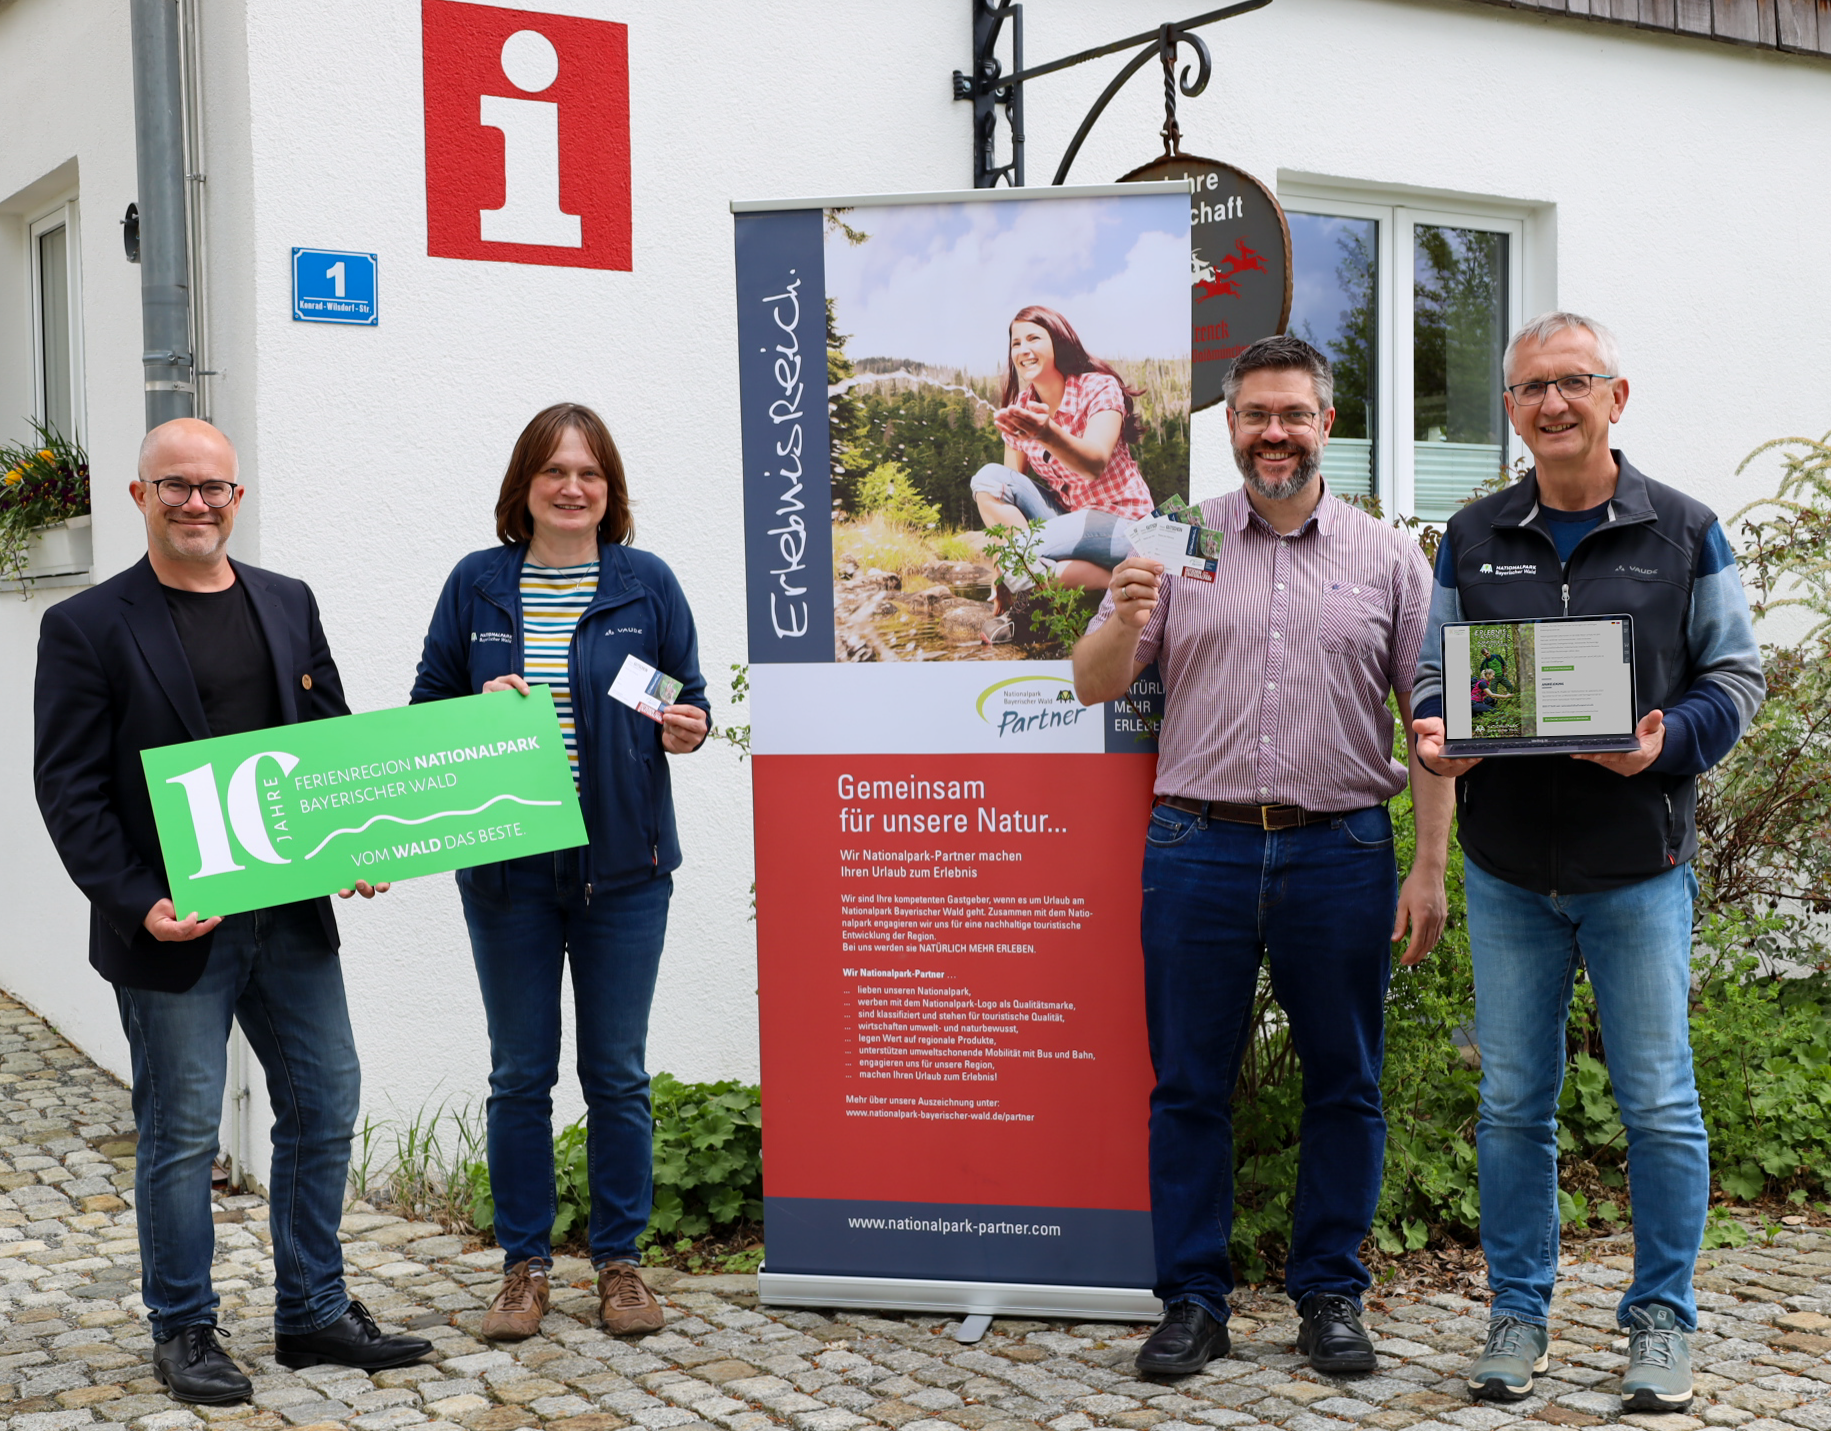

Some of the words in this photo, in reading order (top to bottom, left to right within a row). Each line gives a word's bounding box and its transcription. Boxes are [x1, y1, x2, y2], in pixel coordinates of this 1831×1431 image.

[1191, 196, 1243, 226] chaft
[326, 261, 345, 297] 1
[998, 708, 1087, 738] Partner
[295, 758, 412, 791] FERIENREGION
[414, 736, 541, 770] NATIONALPARK
[837, 774, 984, 799] Gemeinsam
[300, 780, 407, 814] BAYERISCHER
[411, 773, 458, 793] WALD
[264, 776, 292, 843] JAHRE
[839, 807, 874, 832] für
[883, 814, 967, 832] unsere
[978, 807, 1066, 832] Natur...
[351, 848, 391, 868] VOM
[392, 838, 441, 859] WALD
[444, 831, 476, 851] DAS
[478, 822, 527, 843] BESTE.
[839, 849, 859, 860] Wir
[863, 849, 975, 863] Nationalpark-Partner
[978, 849, 1021, 861] machen
[841, 866, 868, 877] Ihren
[872, 865, 906, 877] Urlaub
[909, 869, 930, 877] zum
[933, 866, 977, 878] Erlebnis
[840, 894, 855, 902] Wir
[857, 894, 874, 902] sind
[876, 894, 892, 903] Ihre
[894, 894, 945, 905] kompetenten
[947, 894, 991, 905] Gastgeber,
[1043, 895, 1070, 904] Urlaub
[841, 906, 892, 916] Nationalpark
[893, 906, 940, 916] Bayerischer
[942, 907, 963, 916] Wald
[965, 907, 985, 917] geht.
[987, 907, 1032, 916] Zusammen
[1033, 908, 1046, 916] mit
[1048, 908, 1065, 916] dem
[1068, 908, 1092, 917] Natio-
[841, 918, 871, 928] nalpark
[873, 919, 917, 929] engagieren
[919, 919, 932, 927] wir
[950, 919, 962, 928] für
[964, 919, 982, 928] eine
[984, 919, 1031, 930] nachhaltige
[1033, 920, 1080, 929] touristische
[842, 930, 890, 941] Entwicklung
[892, 931, 905, 939] der
[907, 930, 936, 942] Region.
[842, 942, 855, 951] Bei
[873, 943, 903, 951] werden
[919, 942, 966, 952] NATÜRLICH
[969, 943, 994, 952] MEHR
[996, 943, 1036, 953] ERLEBEN.
[842, 968, 858, 978] Wir
[860, 968, 945, 979] Nationalpark-Partner
[857, 985, 881, 994] lieben
[917, 986, 971, 997] Nationalpark,
[857, 997, 887, 1006] werben
[903, 998, 920, 1006] dem
[922, 998, 997, 1009] Nationalpark-Logo
[999, 999, 1010, 1008] als
[1012, 999, 1075, 1010] Qualitätsmarke,
[858, 1009, 874, 1018] sind
[876, 1009, 920, 1019] klassifiziert
[922, 1011, 936, 1019] und
[939, 1011, 966, 1020] stehen
[968, 1011, 980, 1020] für
[981, 1012, 1029, 1021] touristische
[1031, 1012, 1064, 1022] Qualität,
[858, 1021, 907, 1030] wirtschaften
[909, 1023, 941, 1031] umwelt-
[943, 1023, 958, 1032] und
[960, 1023, 1018, 1033] naturbewusst,
[858, 1034, 880, 1044] legen
[882, 1034, 902, 1042] Wert
[903, 1034, 916, 1043] auf
[918, 1035, 955, 1045] regionale
[957, 1035, 996, 1045] Produkte,
[858, 1046, 907, 1055] unterstützen
[909, 1047, 982, 1056] umweltschonende
[985, 1047, 1020, 1057] Mobilität
[1022, 1049, 1035, 1057] mit
[1036, 1049, 1052, 1058] Bus
[1054, 1050, 1069, 1058] und
[1072, 1049, 1095, 1060] Bahn,
[859, 1058, 903, 1068] engagieren
[921, 1059, 932, 1068] für
[964, 1059, 994, 1070] Region,
[859, 1070, 891, 1078] machen
[893, 1070, 913, 1079] Ihren
[915, 1071, 941, 1080] Urlaub
[961, 1071, 997, 1081] Erlebnis!
[845, 1094, 867, 1103] Mehr
[869, 1095, 887, 1104] über
[889, 1097, 915, 1105] unsere
[917, 1097, 974, 1108] Auszeichnung
[845, 1109, 1034, 1122] www.nationalpark-bayerischer-wald.de/partner
[848, 1216, 1060, 1236] www.nationalpark-partner.com
